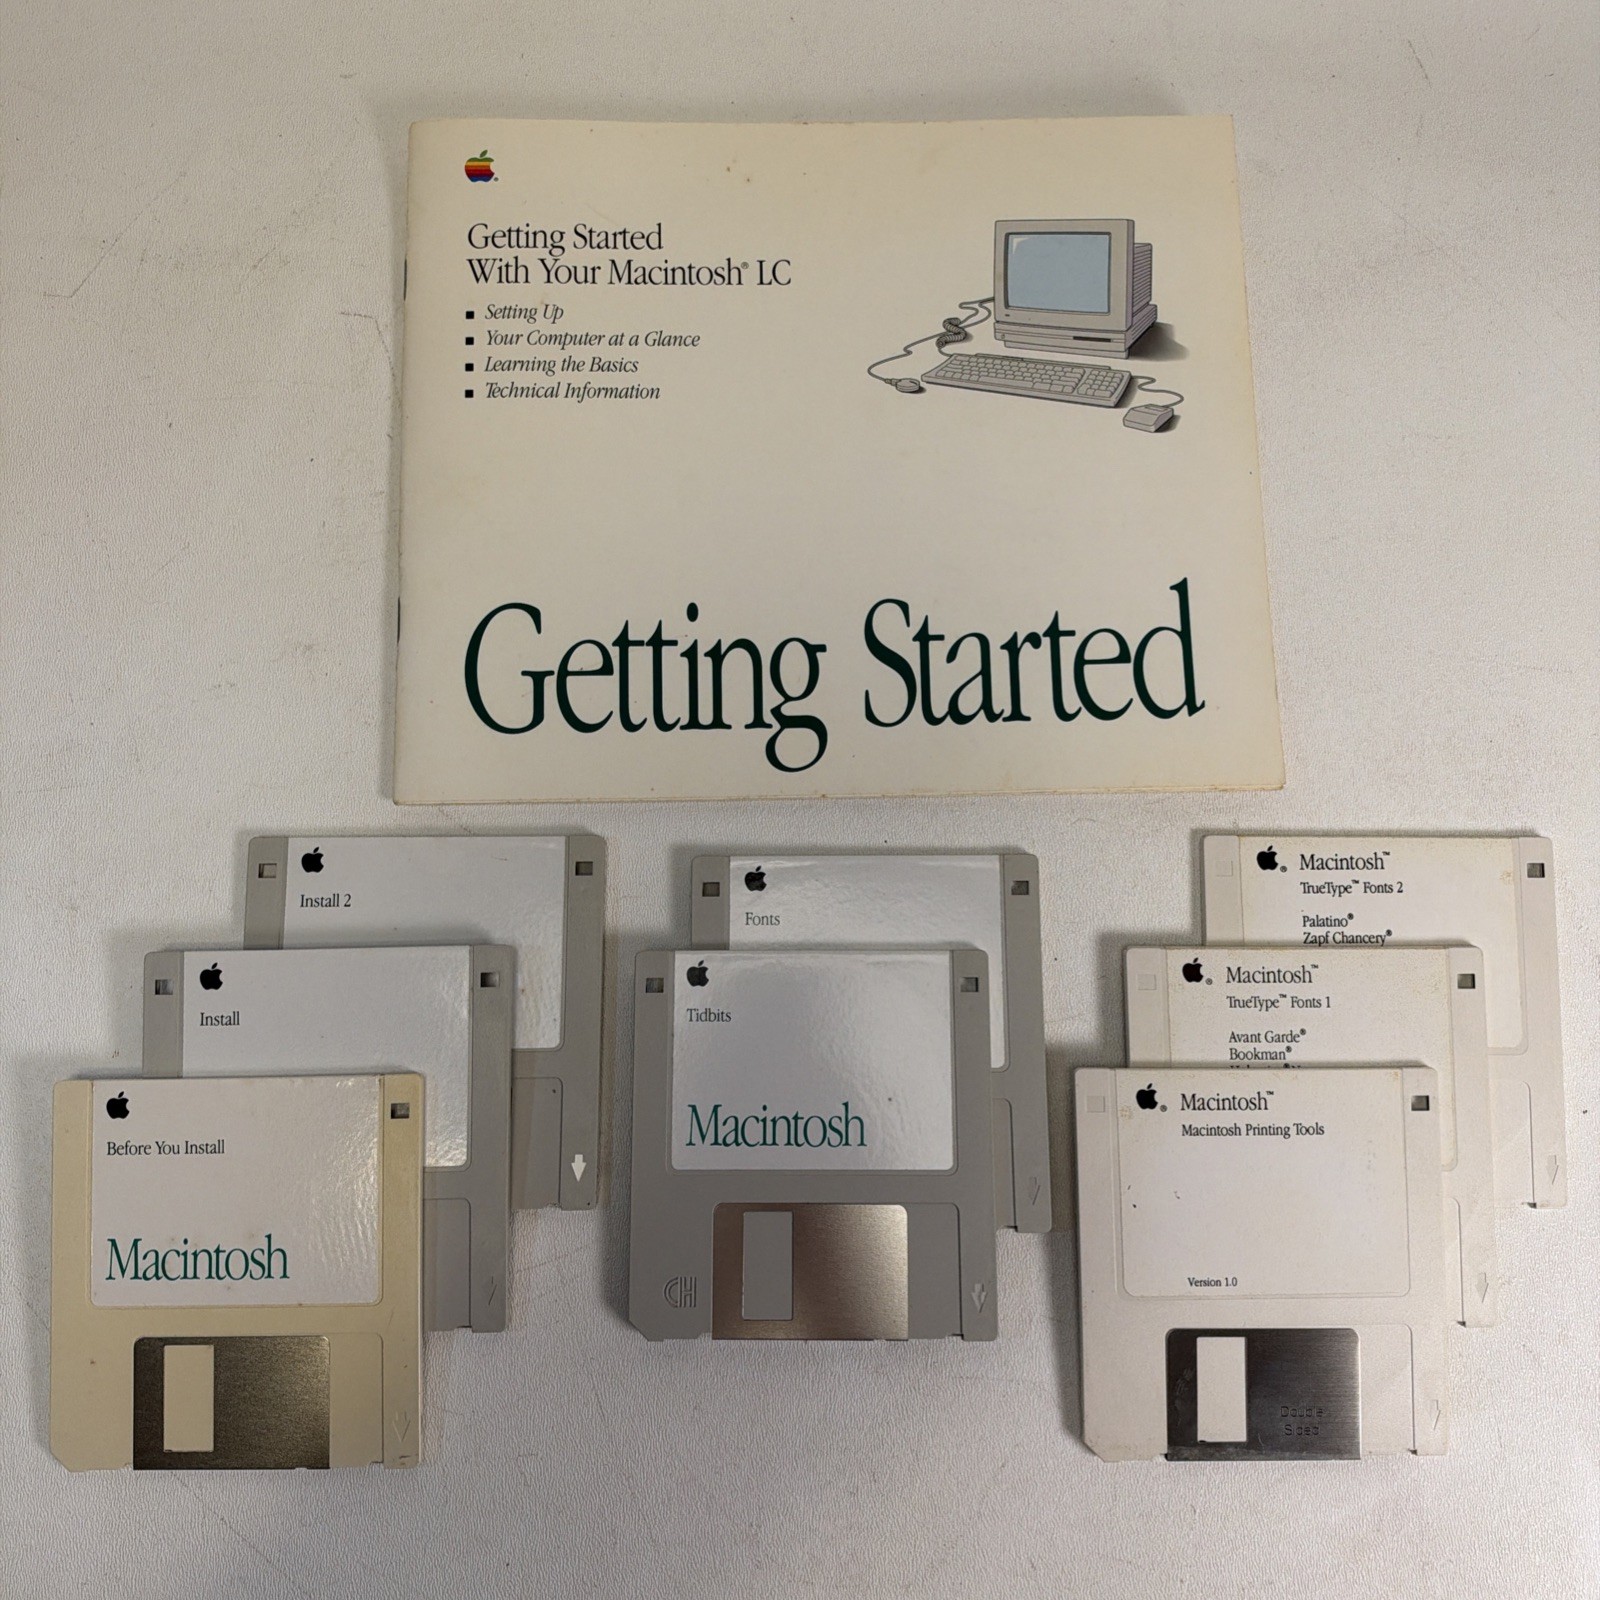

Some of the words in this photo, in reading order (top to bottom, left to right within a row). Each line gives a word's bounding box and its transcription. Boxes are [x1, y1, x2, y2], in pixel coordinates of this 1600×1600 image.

[467, 222, 566, 257] Getting
[573, 222, 664, 251] Started
[466, 255, 531, 284] With
[537, 257, 602, 285] Your
[756, 259, 792, 286] LC
[484, 303, 538, 325] Setting
[543, 303, 564, 323] Up
[486, 329, 524, 346] Your
[526, 329, 606, 351] Computer
[607, 332, 625, 347] at
[628, 334, 640, 347] a
[644, 329, 701, 348] Glance
[484, 356, 557, 377] Learning
[560, 355, 586, 373] the
[589, 356, 640, 373] Basics
[485, 381, 561, 399] Technical
[563, 381, 661, 404] Information
[464, 602, 828, 773] Getting
[863, 576, 1206, 728] Started
[1362, 881, 1394, 894] Fonts
[1396, 880, 1404, 894] 2
[299, 893, 340, 908] Install
[343, 893, 352, 908] 2
[744, 911, 781, 927] Fonts
[1303, 930, 1330, 946] Zapf
[1290, 995, 1322, 1009] Fonts
[1325, 995, 1331, 1009] 1
[199, 1010, 240, 1027] Install
[686, 1007, 732, 1023] Tidbits
[1228, 1030, 1262, 1044] Avant
[685, 1100, 868, 1148] Macintosh
[1181, 1122, 1242, 1137] Macintosh
[1245, 1123, 1291, 1140] Printing
[1292, 1121, 1325, 1136] Tools
[106, 1139, 152, 1156] Before
[154, 1140, 181, 1156] You
[184, 1139, 225, 1155] Install
[105, 1233, 290, 1282] Macintosh
[1187, 1276, 1221, 1288] Version
[1223, 1276, 1238, 1288] 1.0
[1280, 1406, 1324, 1418] Double
